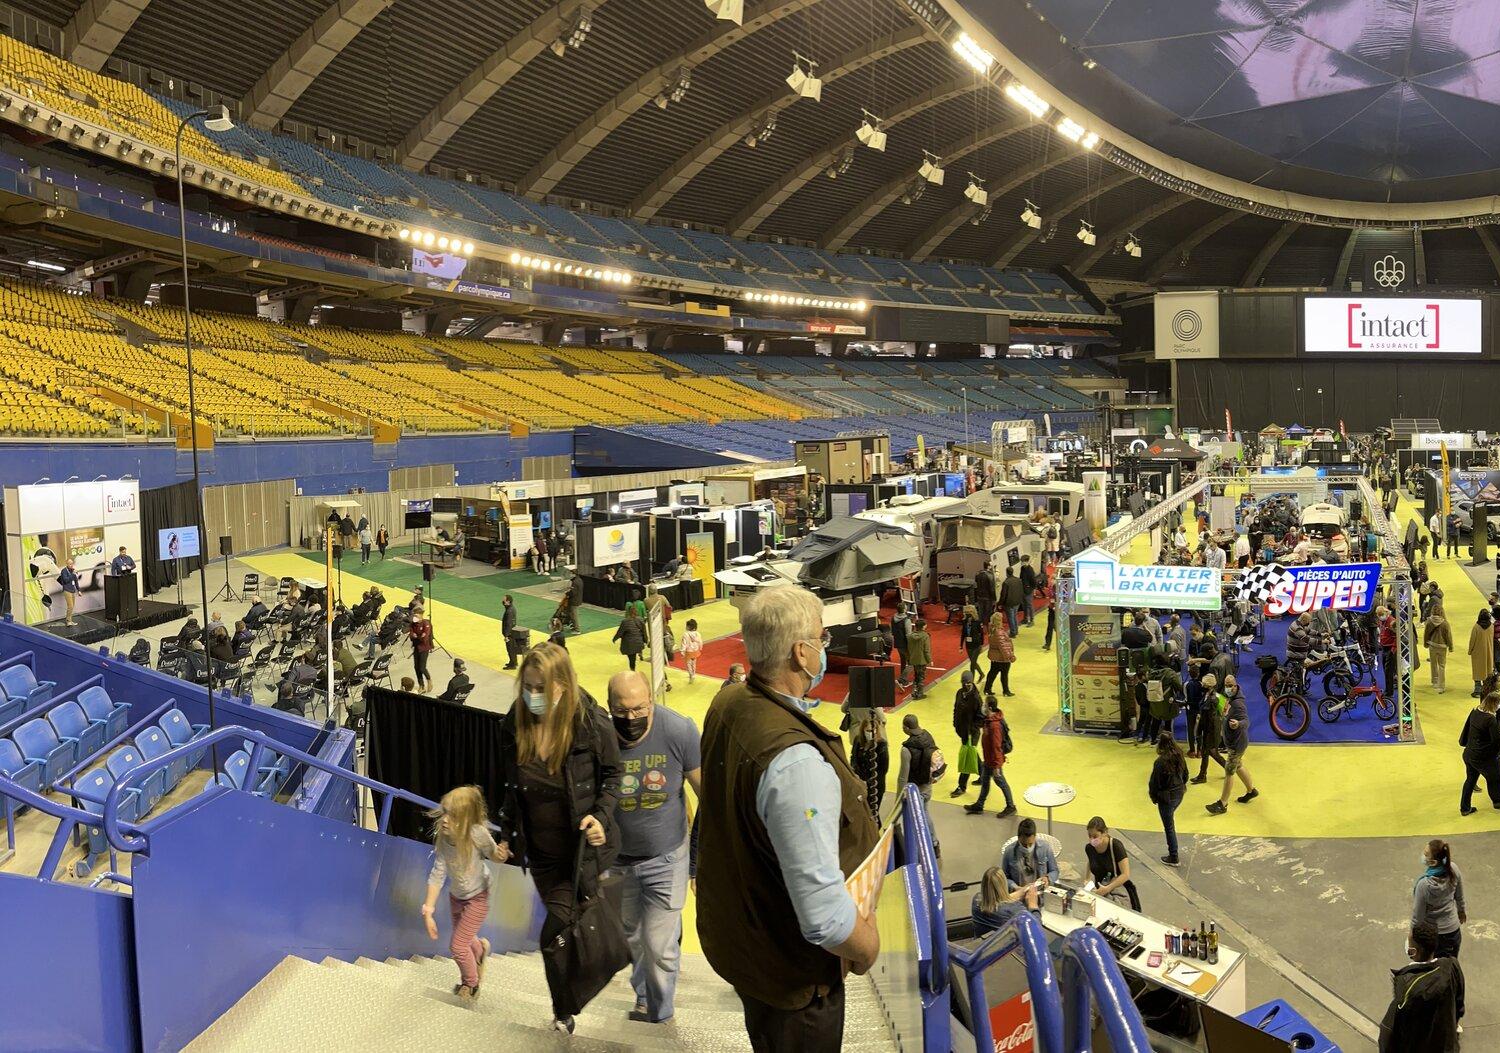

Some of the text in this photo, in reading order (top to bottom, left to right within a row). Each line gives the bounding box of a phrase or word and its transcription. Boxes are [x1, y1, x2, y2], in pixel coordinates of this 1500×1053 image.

[458, 284, 511, 299] parcolympique.ca
[1360, 311, 1429, 338] intact
[111, 497, 132, 509] intact
[1118, 567, 1212, 580] L'ATELIER
[1297, 569, 1366, 580] PIÈCES D'AUTO
[1268, 580, 1368, 614] SUPER
[645, 754, 667, 768] UP!
